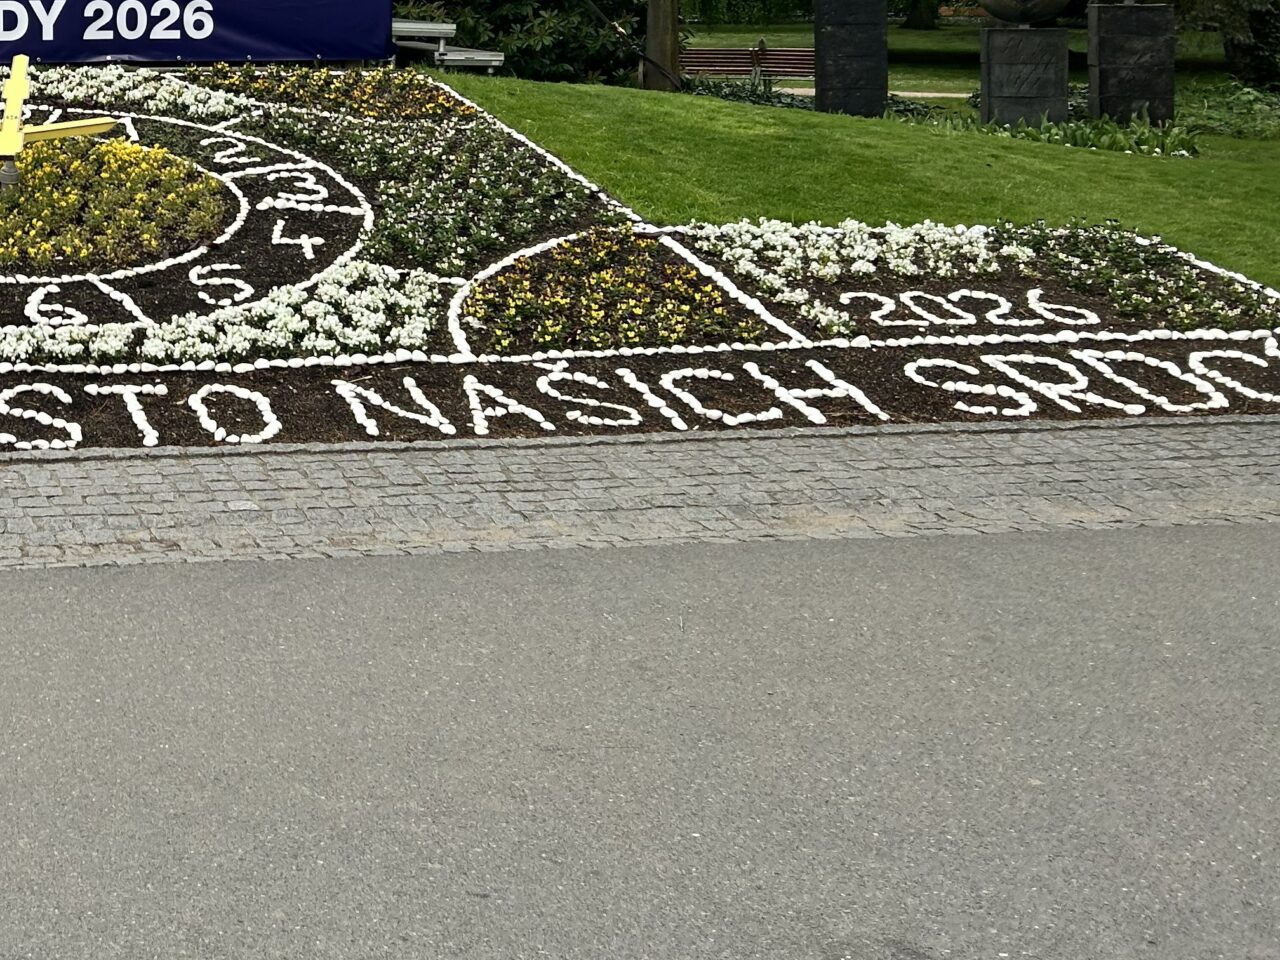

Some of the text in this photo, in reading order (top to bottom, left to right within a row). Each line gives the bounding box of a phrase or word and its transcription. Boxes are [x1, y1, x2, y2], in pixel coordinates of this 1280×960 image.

[199, 137, 261, 164] 2
[266, 170, 329, 203] 3
[271, 219, 325, 260] 4
[23, 283, 89, 326] 6
[188, 263, 255, 307] 5
[838, 288, 1100, 329] 2026
[330, 358, 891, 436] NAŠICH
[904, 336, 1280, 417] SRDC
